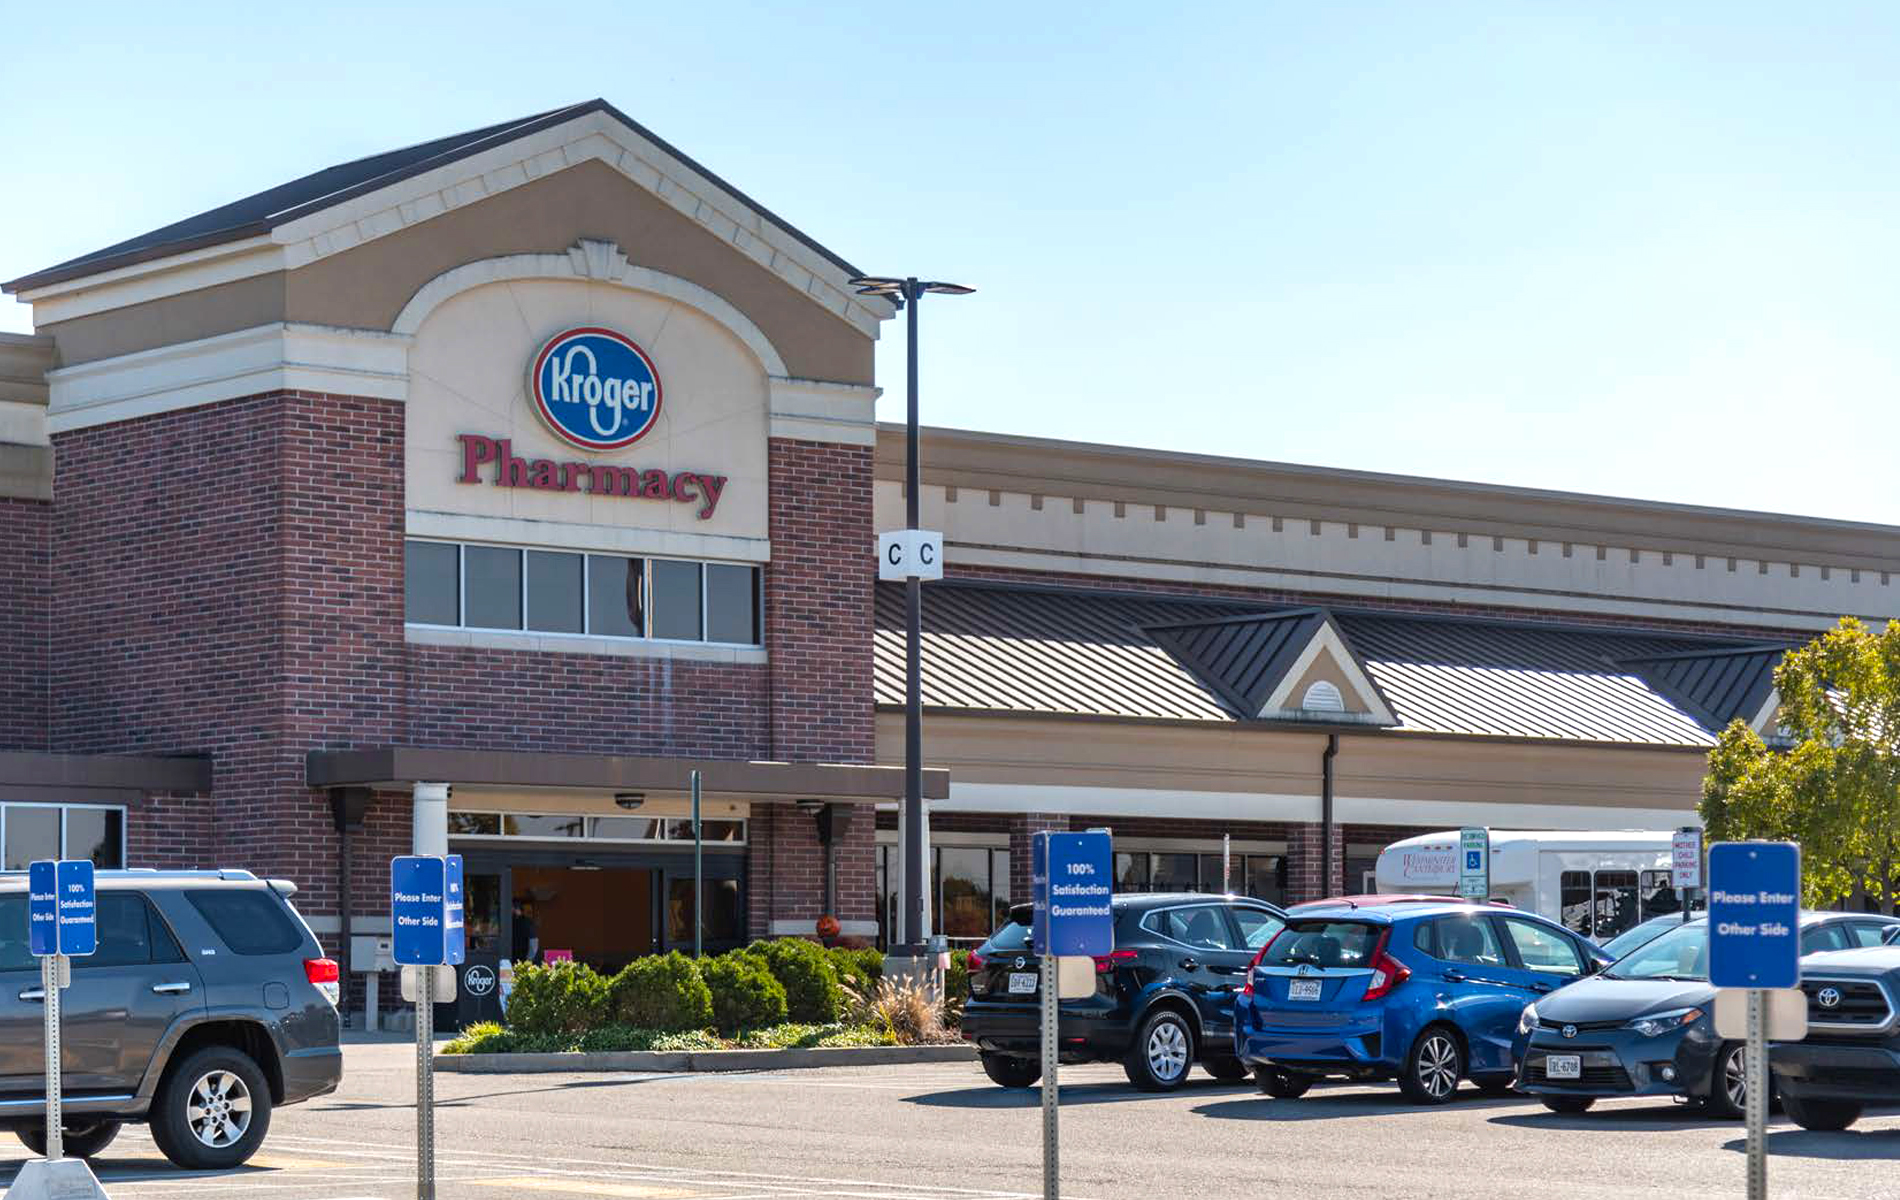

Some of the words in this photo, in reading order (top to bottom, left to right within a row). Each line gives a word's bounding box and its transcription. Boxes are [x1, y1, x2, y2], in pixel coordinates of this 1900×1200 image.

[552, 345, 653, 436] Kroger
[455, 434, 728, 520] Pharmacy
[888, 543, 901, 566] C
[920, 543, 933, 565] C
[1066, 863, 1095, 875] 100%
[68, 884, 85, 893] 100%
[1052, 884, 1109, 896] Satisfaction
[394, 892, 420, 902] Please
[422, 893, 441, 902] Enter
[1713, 891, 1756, 904] Please
[1760, 891, 1795, 904] Enter
[60, 900, 93, 909] Satisfaction
[1052, 905, 1110, 917] Guaranteed
[60, 914, 94, 924] Guaranteed
[398, 916, 420, 926] Other
[422, 916, 439, 926] Side
[1717, 922, 1757, 935] Other
[1760, 922, 1790, 935] Side
[468, 970, 492, 991] Kroger
